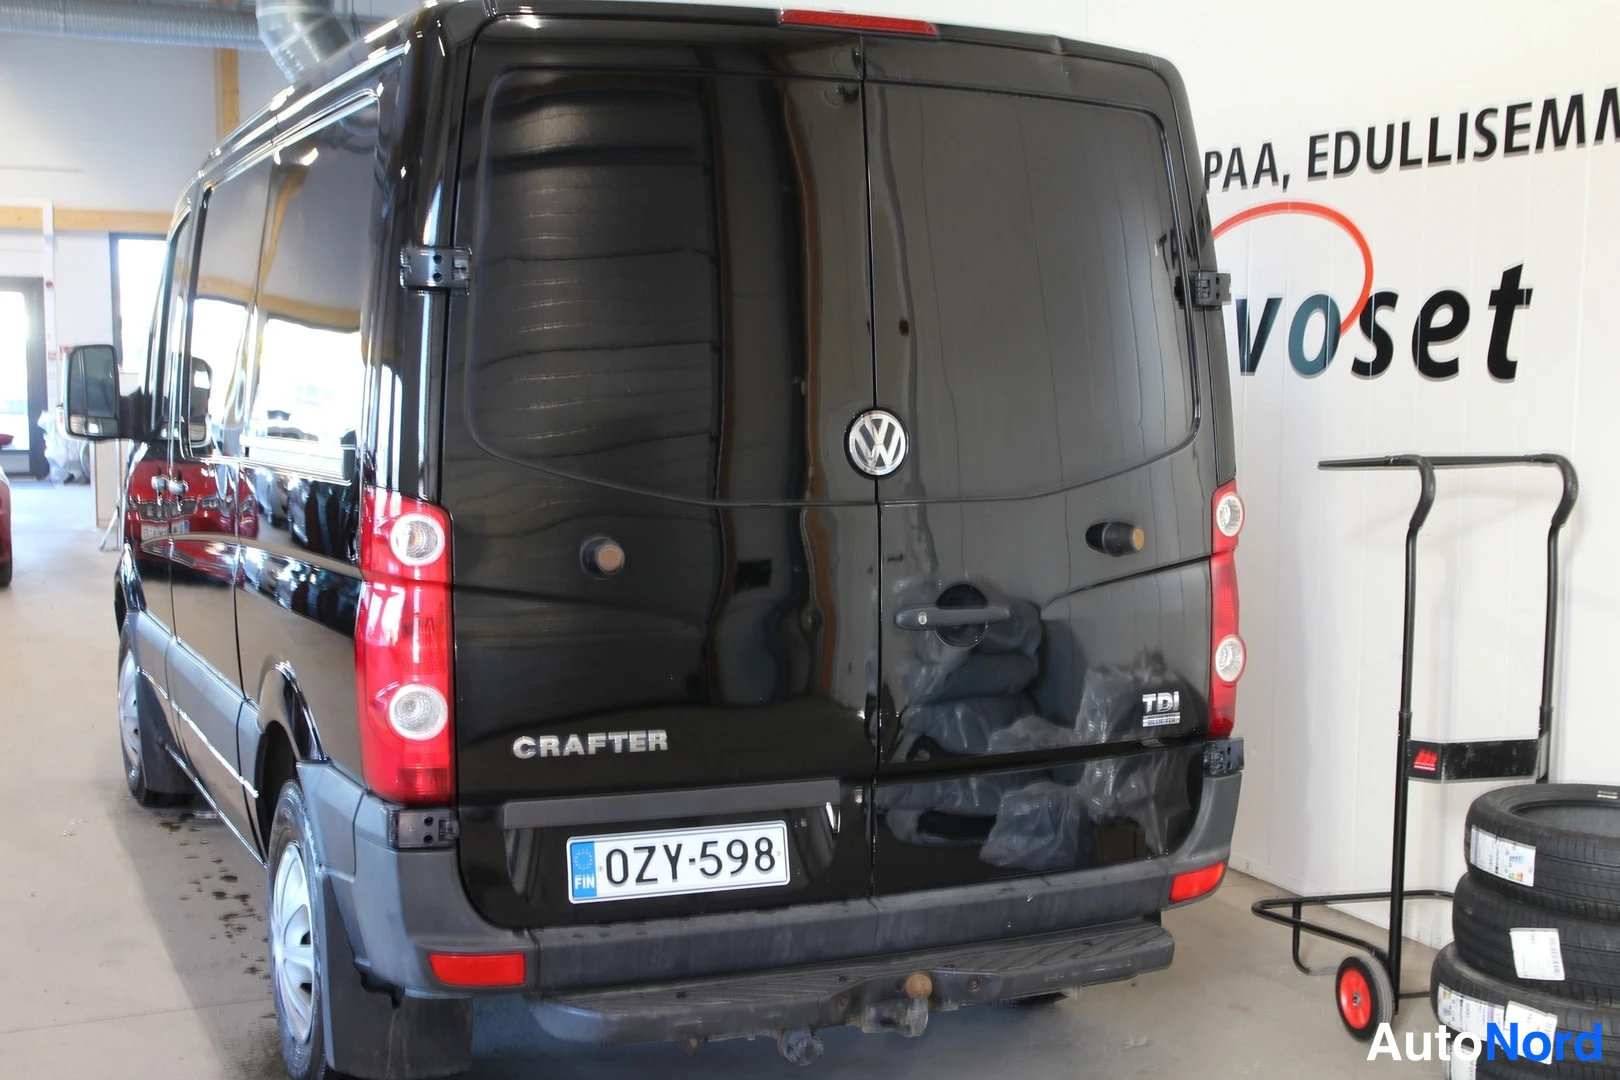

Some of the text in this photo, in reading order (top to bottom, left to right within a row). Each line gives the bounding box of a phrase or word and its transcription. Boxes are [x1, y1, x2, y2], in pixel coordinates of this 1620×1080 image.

[1235, 263, 1534, 380] voset
[1142, 691, 1180, 713] TDI
[512, 729, 668, 759] CRAFTER
[574, 837, 775, 890] FIN OZY-598
